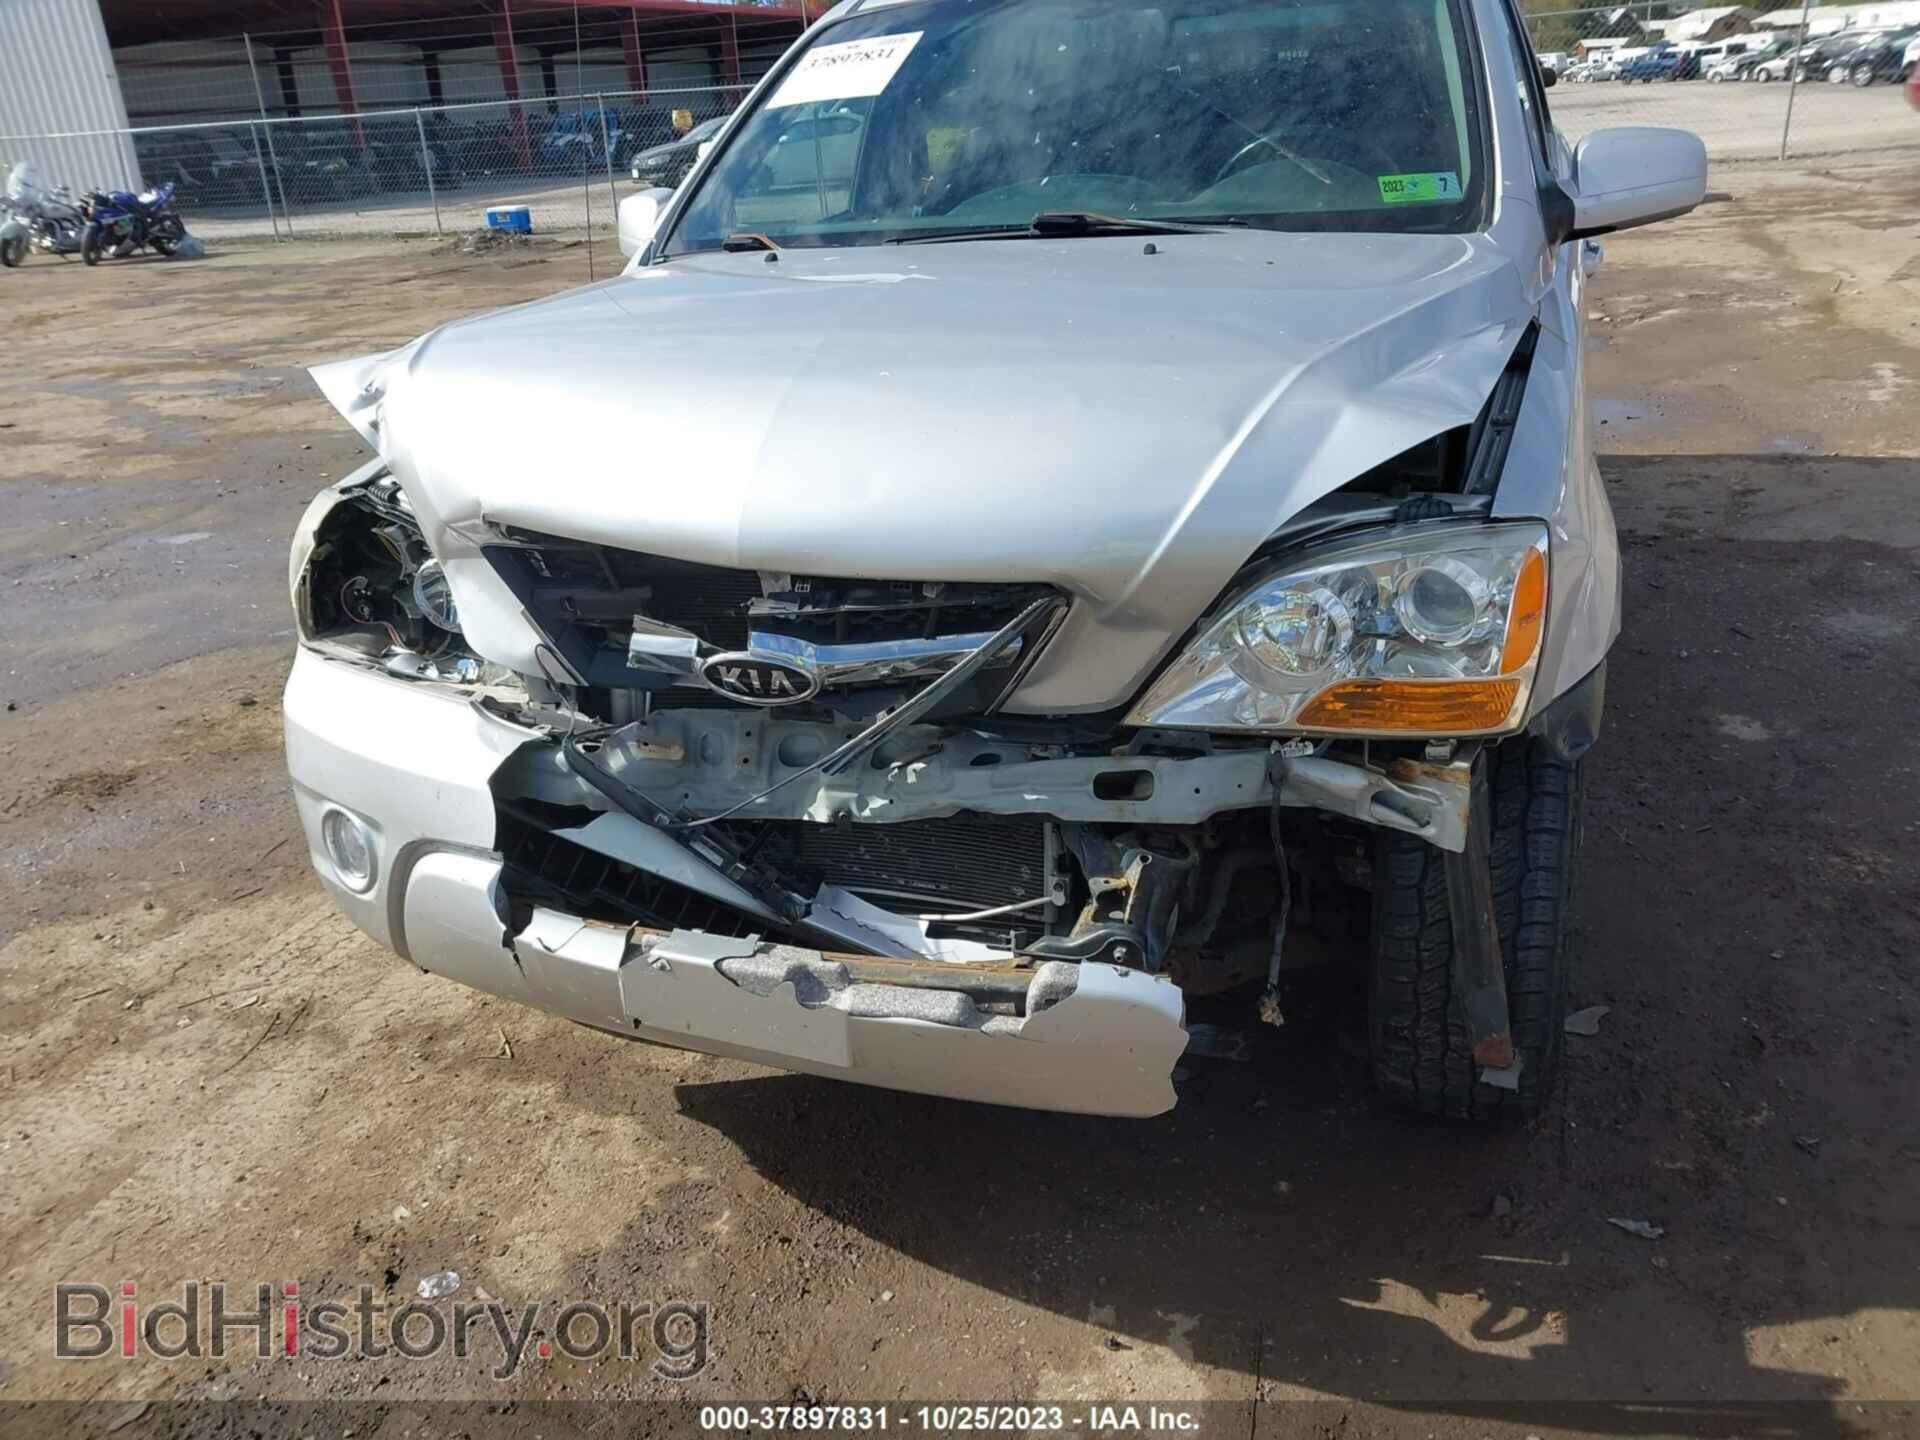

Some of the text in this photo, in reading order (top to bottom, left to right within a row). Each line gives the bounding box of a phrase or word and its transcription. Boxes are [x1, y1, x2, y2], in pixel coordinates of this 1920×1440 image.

[1382, 178, 1447, 192] 2023 7
[716, 664, 799, 696] KIA
